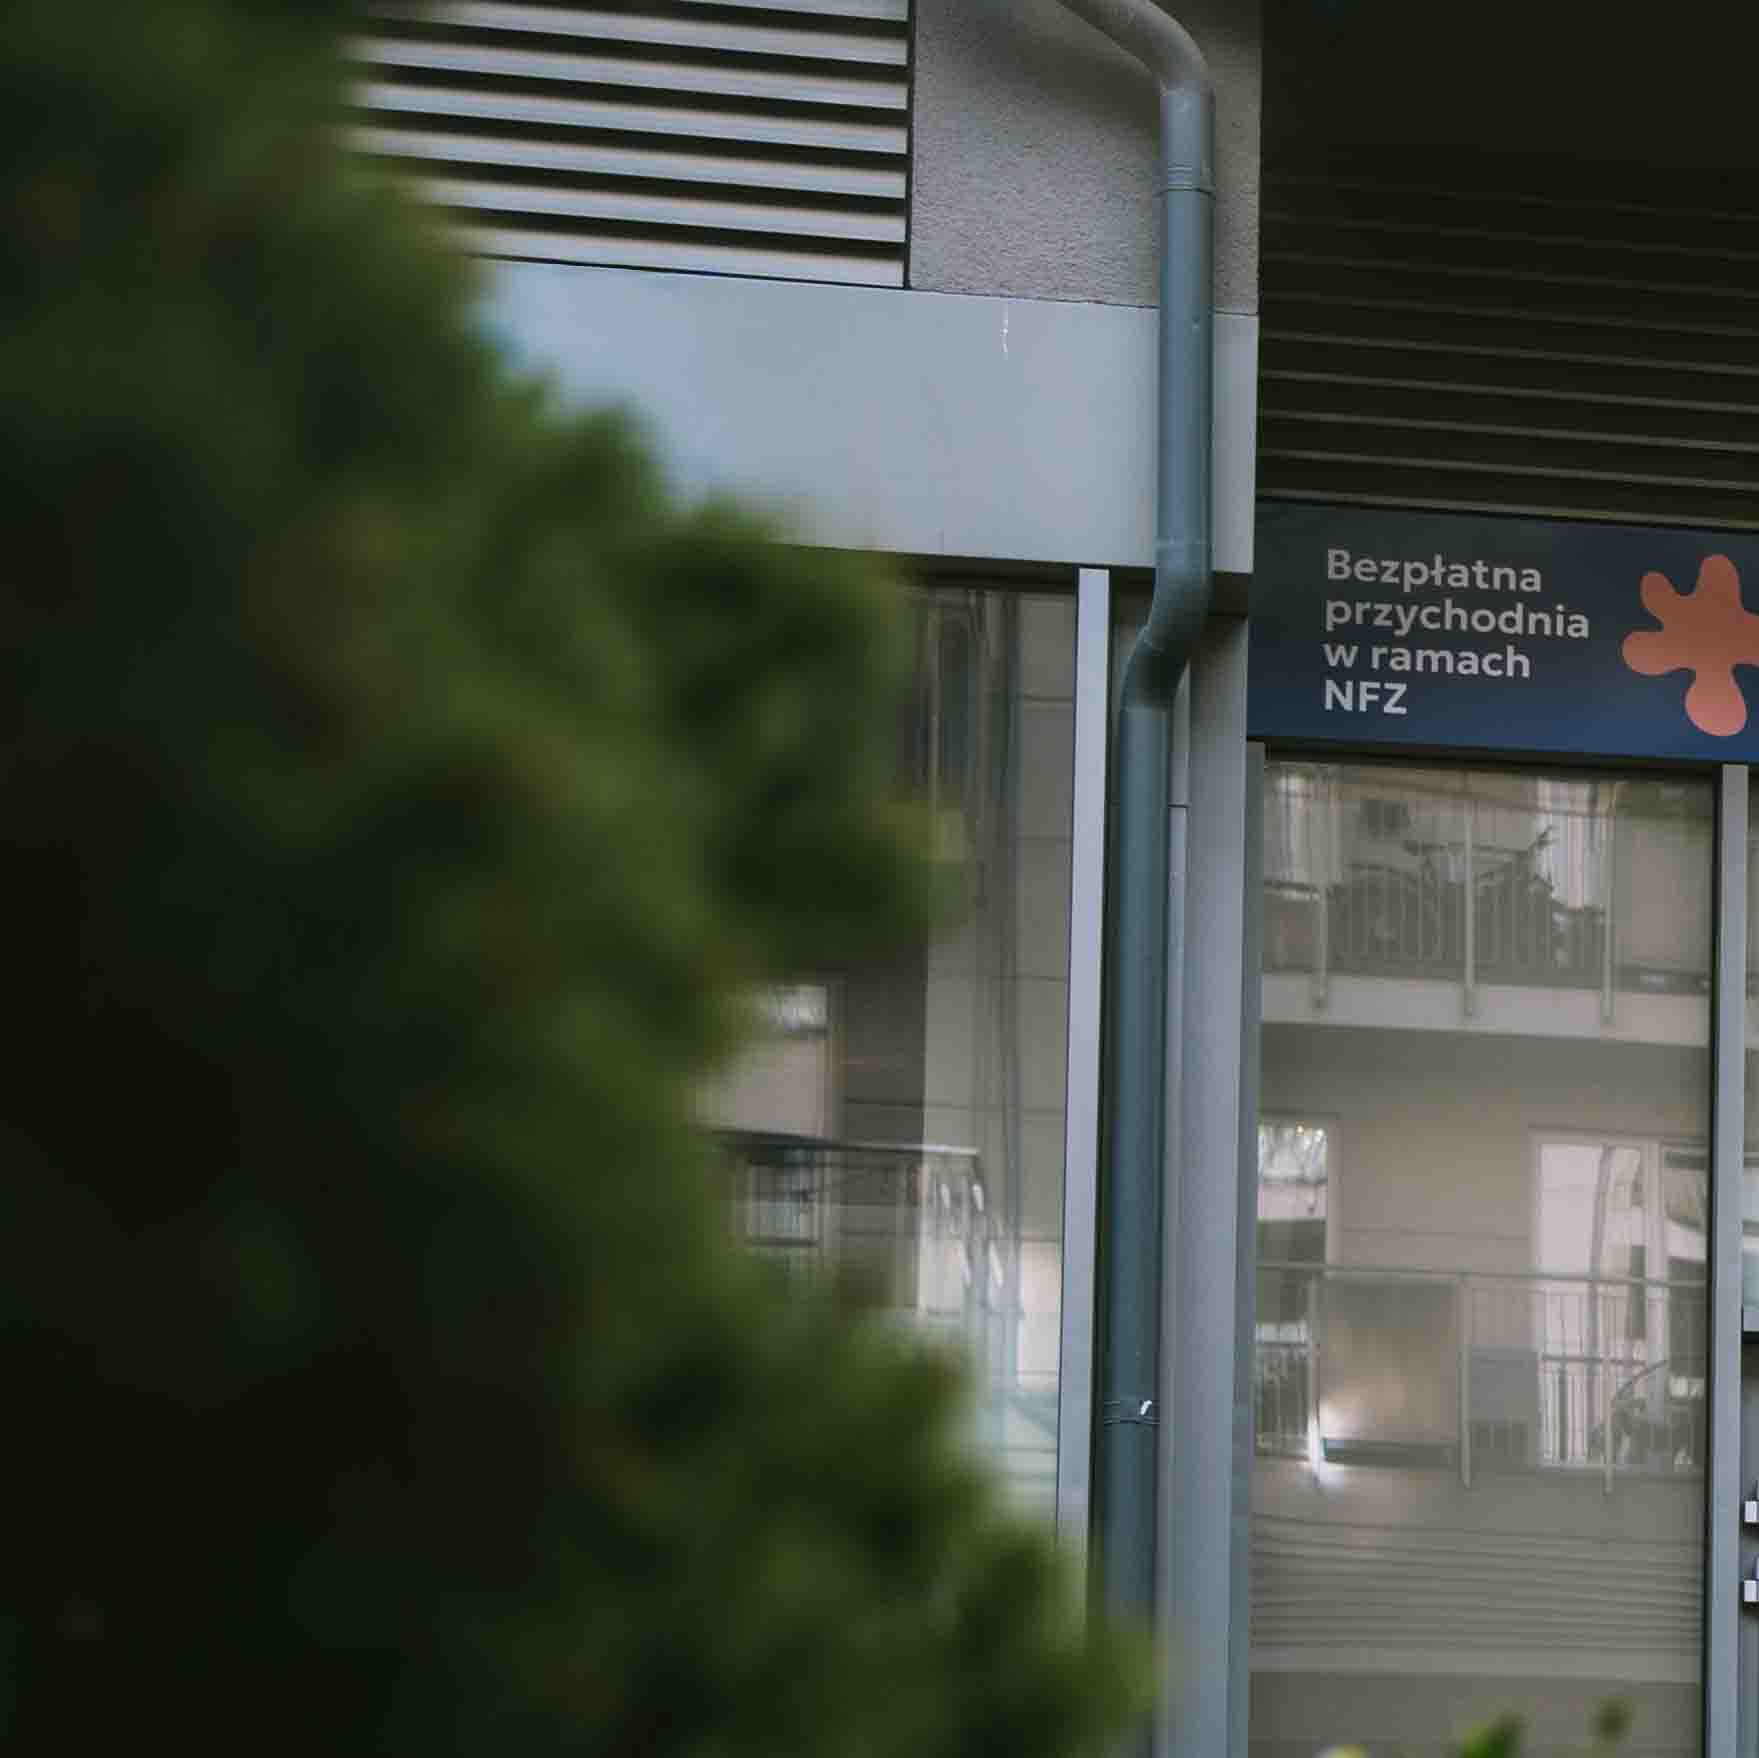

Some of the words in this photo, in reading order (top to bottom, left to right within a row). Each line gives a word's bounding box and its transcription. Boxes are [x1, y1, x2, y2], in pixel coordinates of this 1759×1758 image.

[1327, 549, 1542, 593] Bezpłatna
[1326, 598, 1589, 639] przychodnia
[1323, 643, 1359, 668] w
[1371, 645, 1531, 678] ramach
[1325, 679, 1408, 715] NFZ
